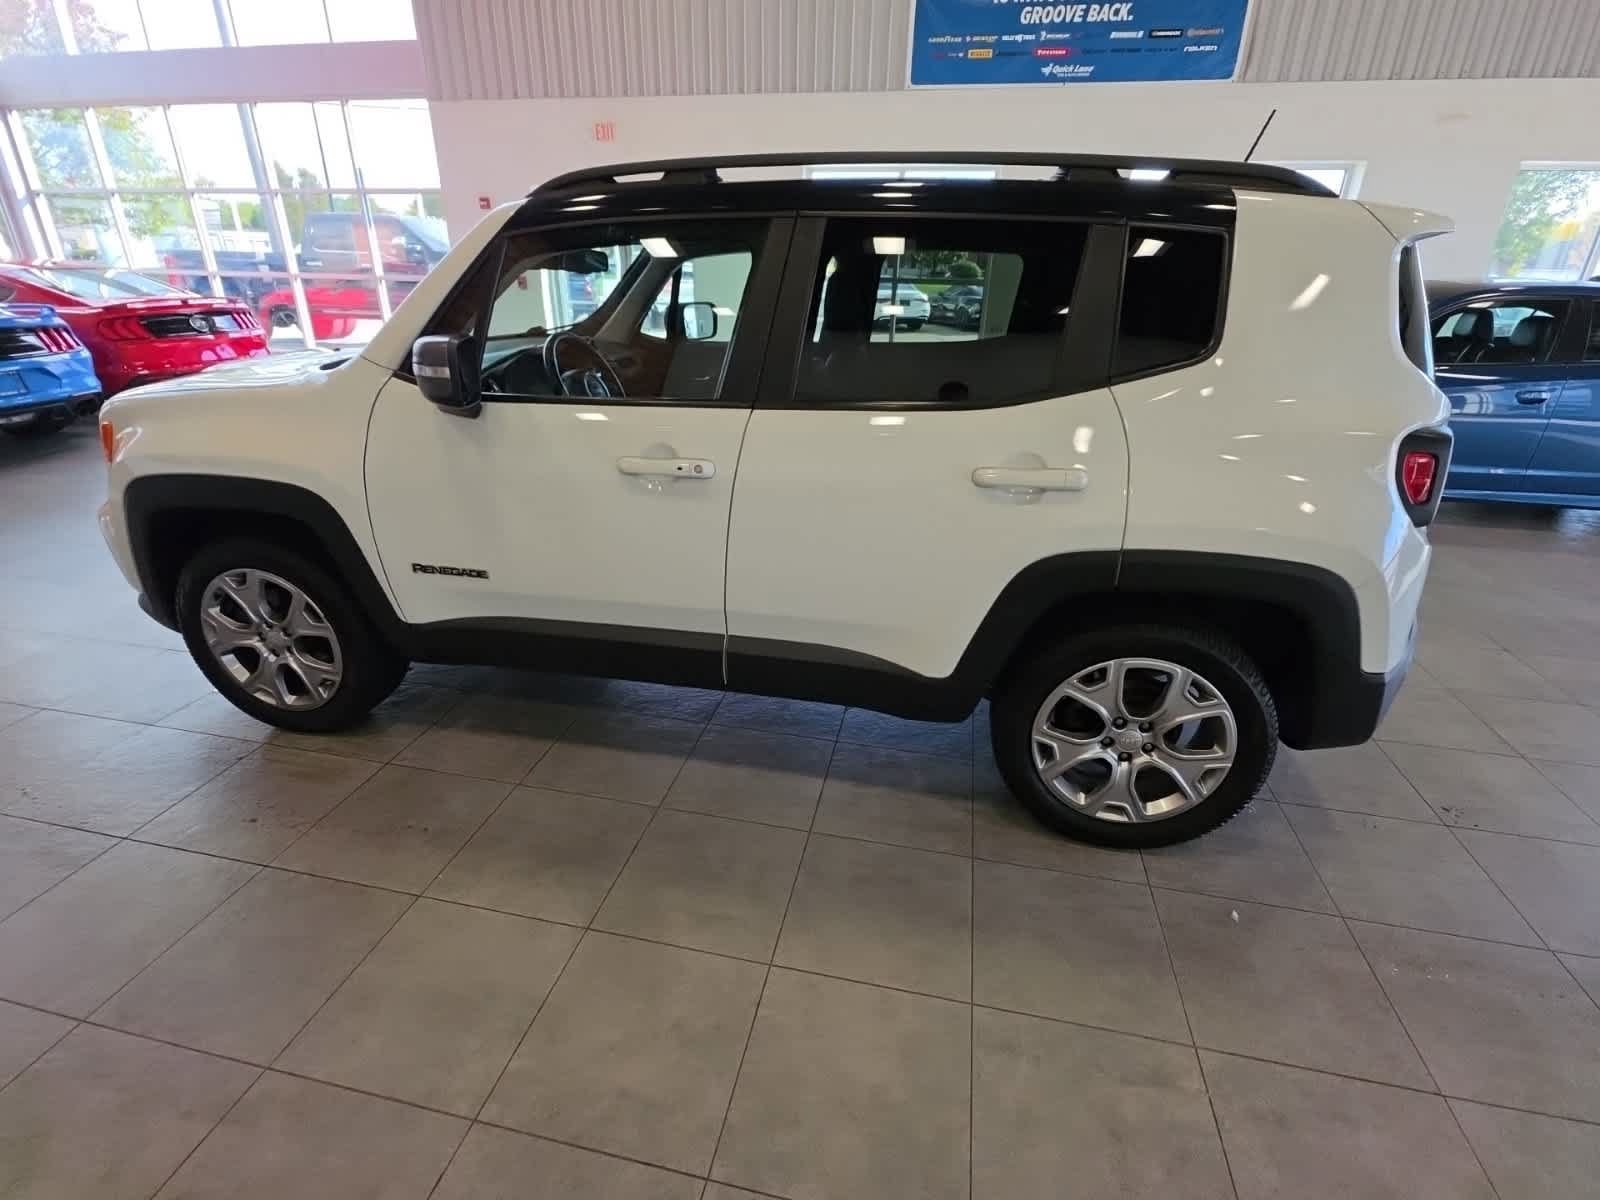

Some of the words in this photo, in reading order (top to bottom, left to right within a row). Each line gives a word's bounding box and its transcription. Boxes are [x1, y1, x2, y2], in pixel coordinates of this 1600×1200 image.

[1020, 4, 1087, 24] GROOVE
[1087, 3, 1134, 22] BACK.
[411, 562, 489, 579] RENEGADE
